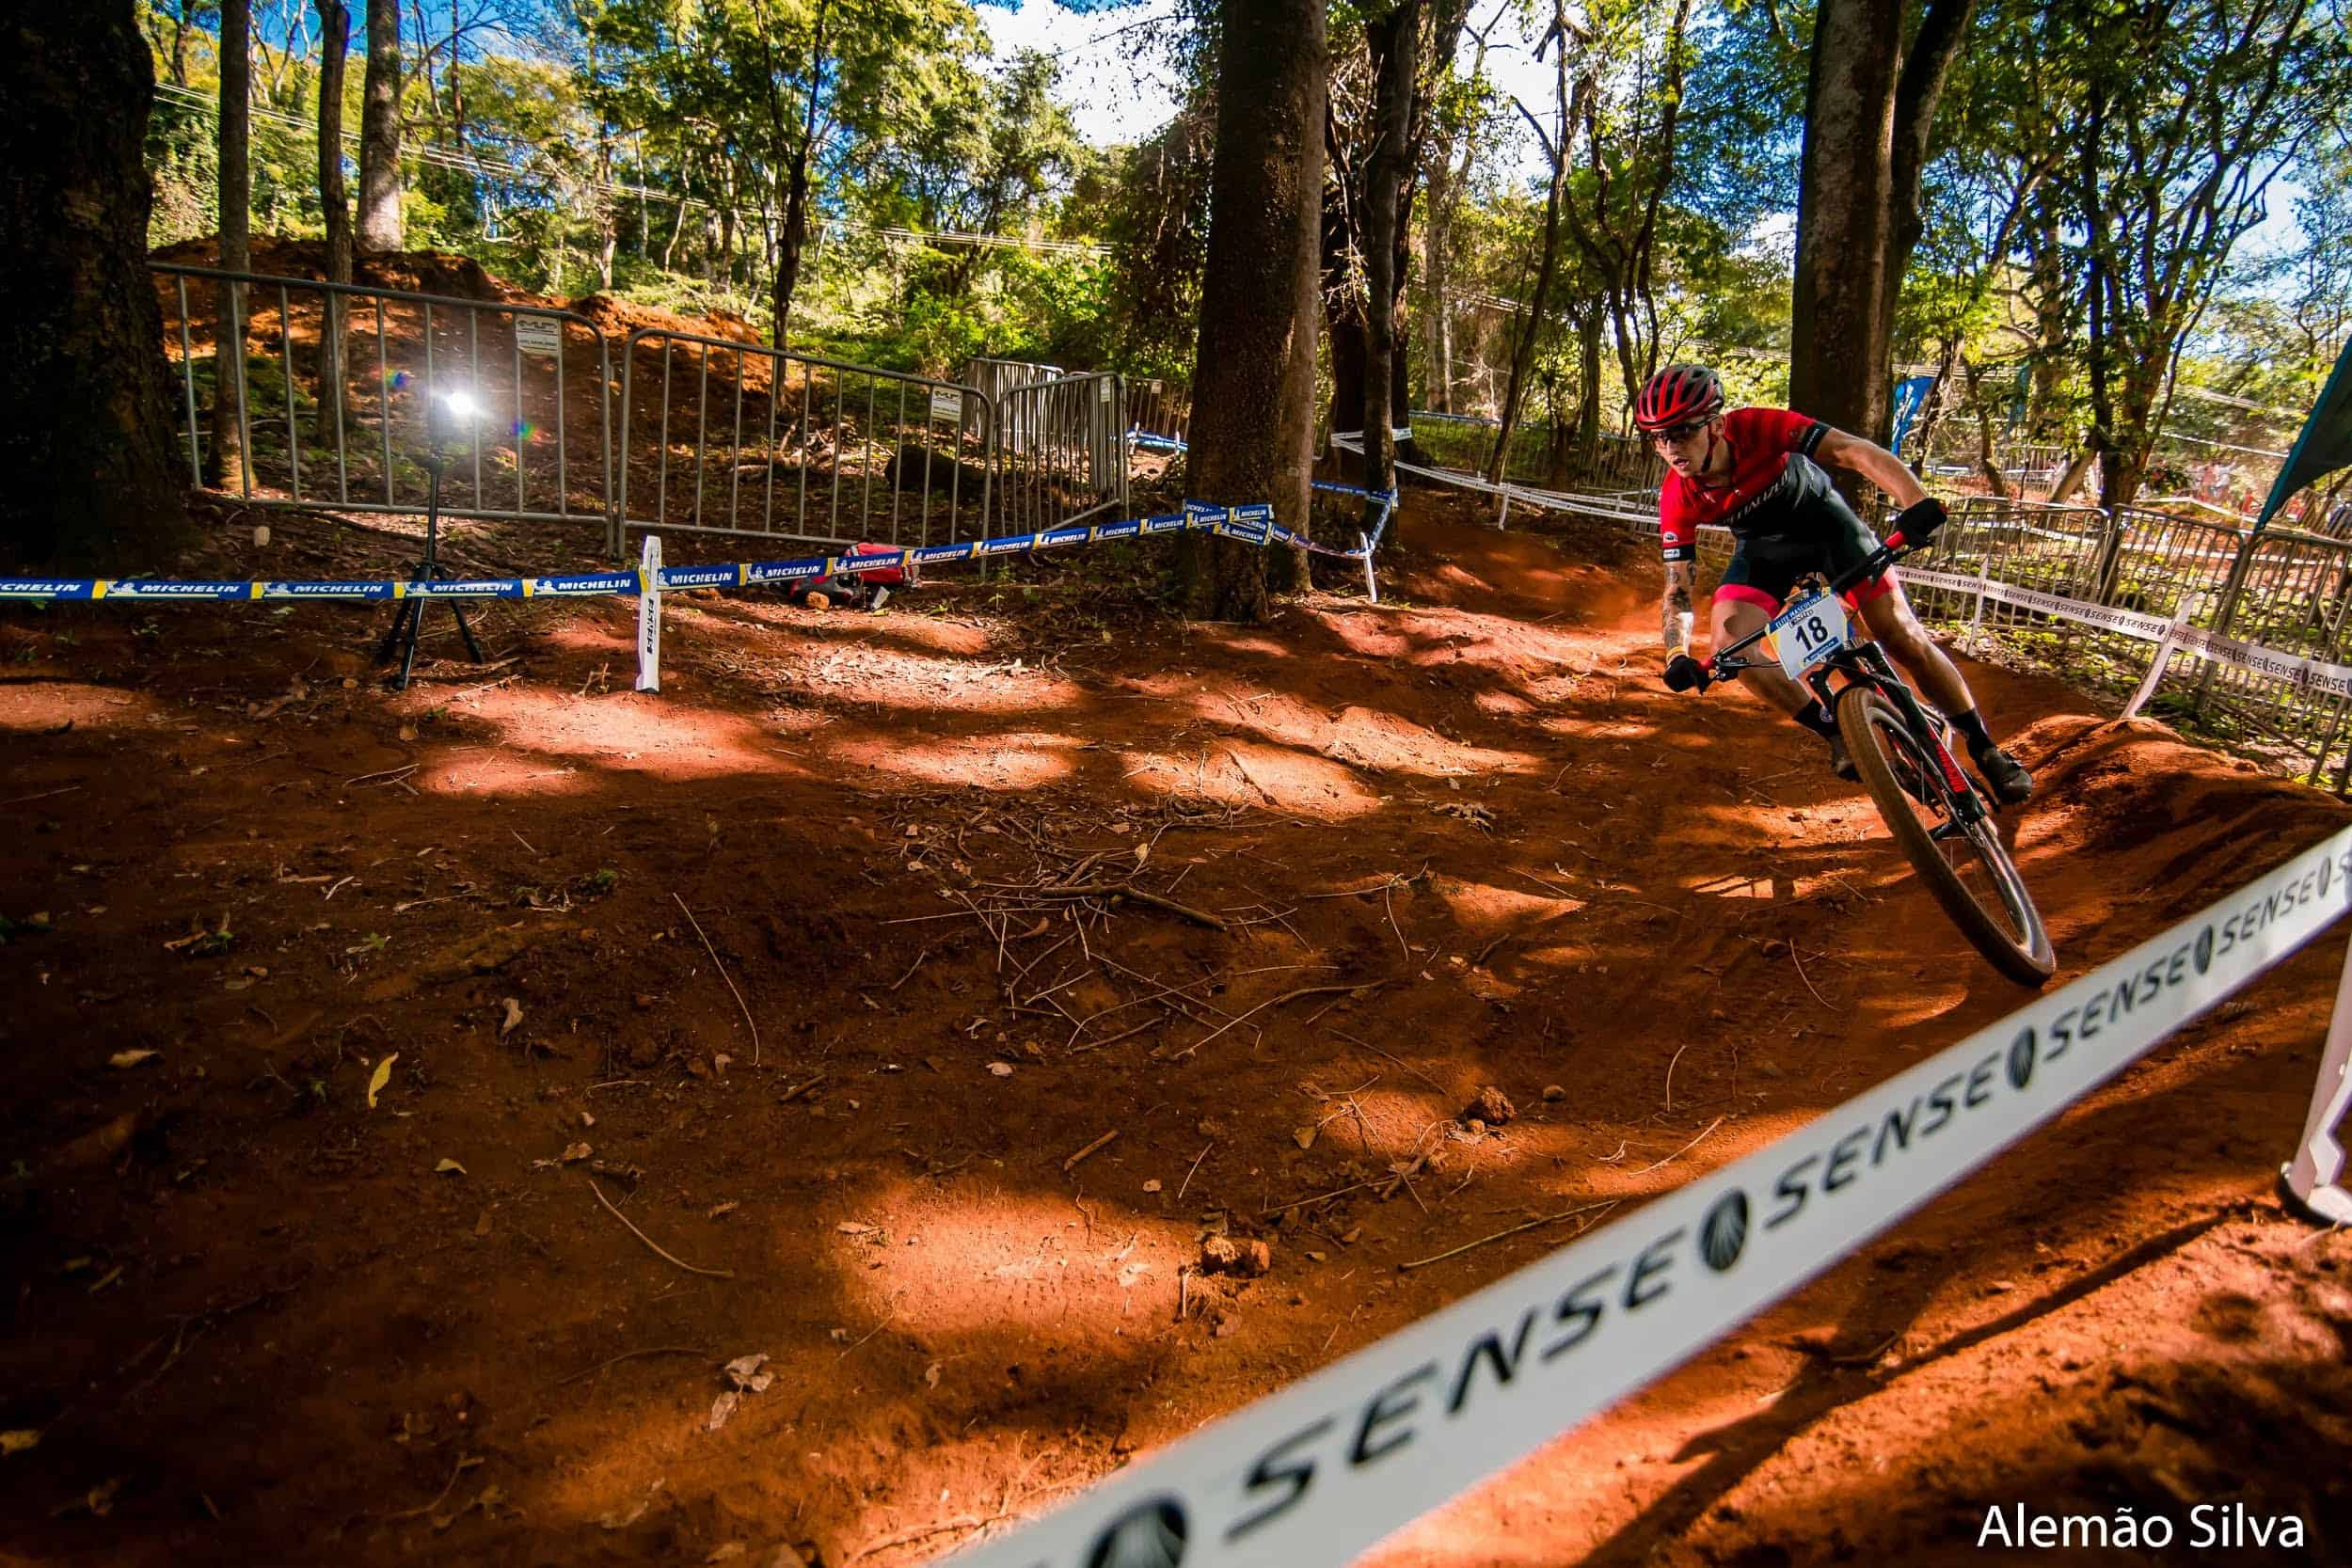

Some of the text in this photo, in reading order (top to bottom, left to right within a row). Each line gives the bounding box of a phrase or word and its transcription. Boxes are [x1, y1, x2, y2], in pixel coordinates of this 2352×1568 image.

[0, 583, 82, 592] CHELIN
[141, 584, 240, 593] MICHELIN
[433, 583, 513, 592] MICHELIN
[558, 578, 631, 590] MICHELIN
[671, 572, 732, 584] MICHELIN
[766, 565, 820, 577] MICHELIN
[849, 557, 898, 570] MICHELIN
[924, 548, 968, 561] MICHELIN
[990, 541, 1030, 552] MICHELIN
[1050, 533, 1086, 544] MICHELIN
[1104, 526, 1136, 537] MICHELIN
[1154, 519, 1184, 530] MICHELIN
[1795, 616, 1828, 651] 18
[2059, 604, 2086, 617] SENSE
[2090, 610, 2119, 624] SENSE
[2125, 618, 2159, 633] SENSE
[2211, 642, 2235, 657] SENSE
[2237, 650, 2265, 669] SENSE
[2269, 662, 2302, 682] SENSE
[2309, 673, 2346, 693] SENSE
[1223, 869, 2317, 1545] SENSE SENSE SENSE SENSE
